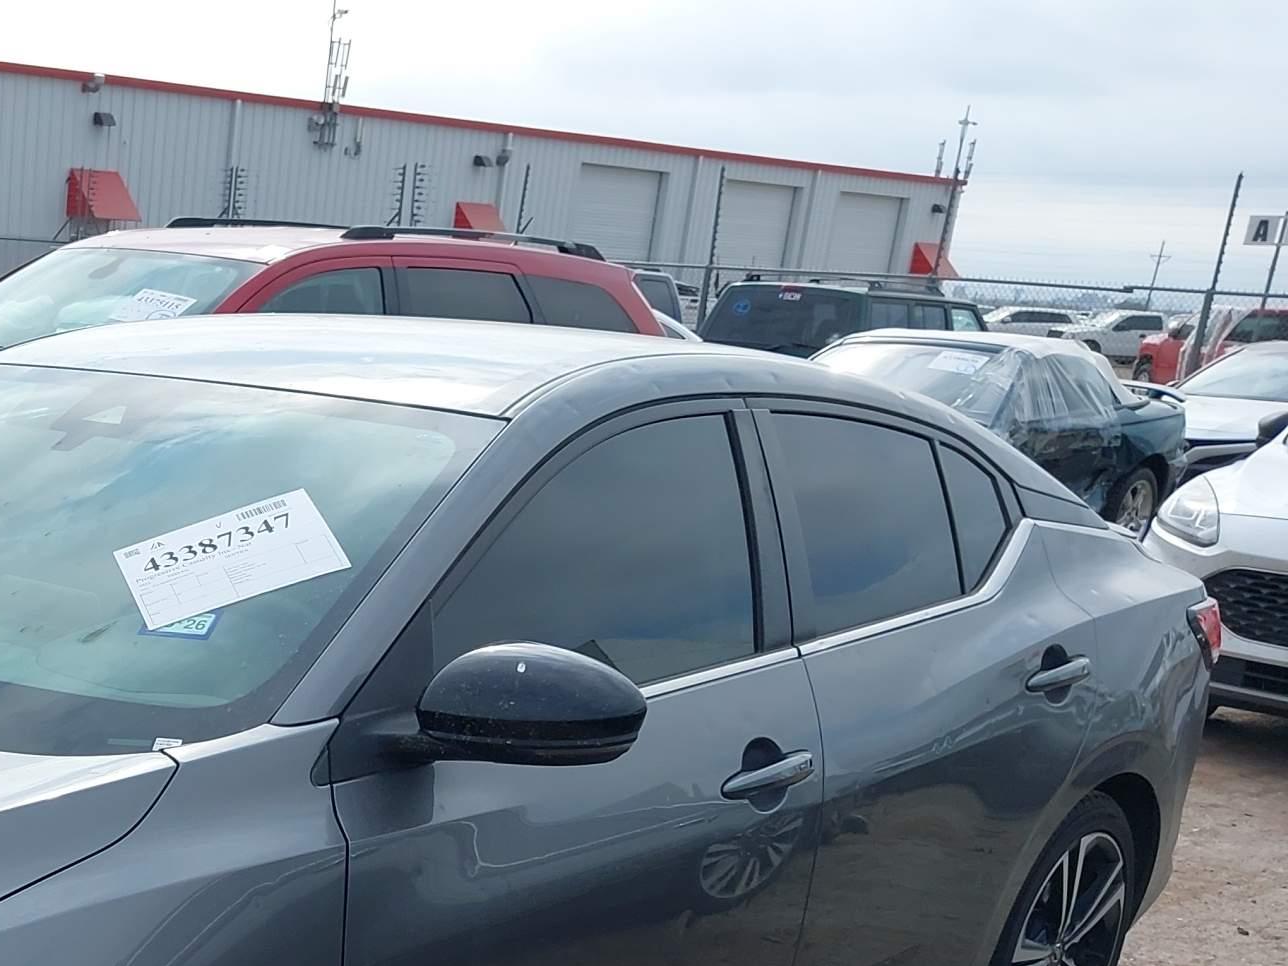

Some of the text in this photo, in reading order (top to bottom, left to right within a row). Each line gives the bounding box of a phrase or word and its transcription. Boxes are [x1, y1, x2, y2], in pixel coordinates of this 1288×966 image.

[1252, 219, 1270, 242] A
[143, 512, 290, 572] 43387347
[184, 619, 208, 631] 26
